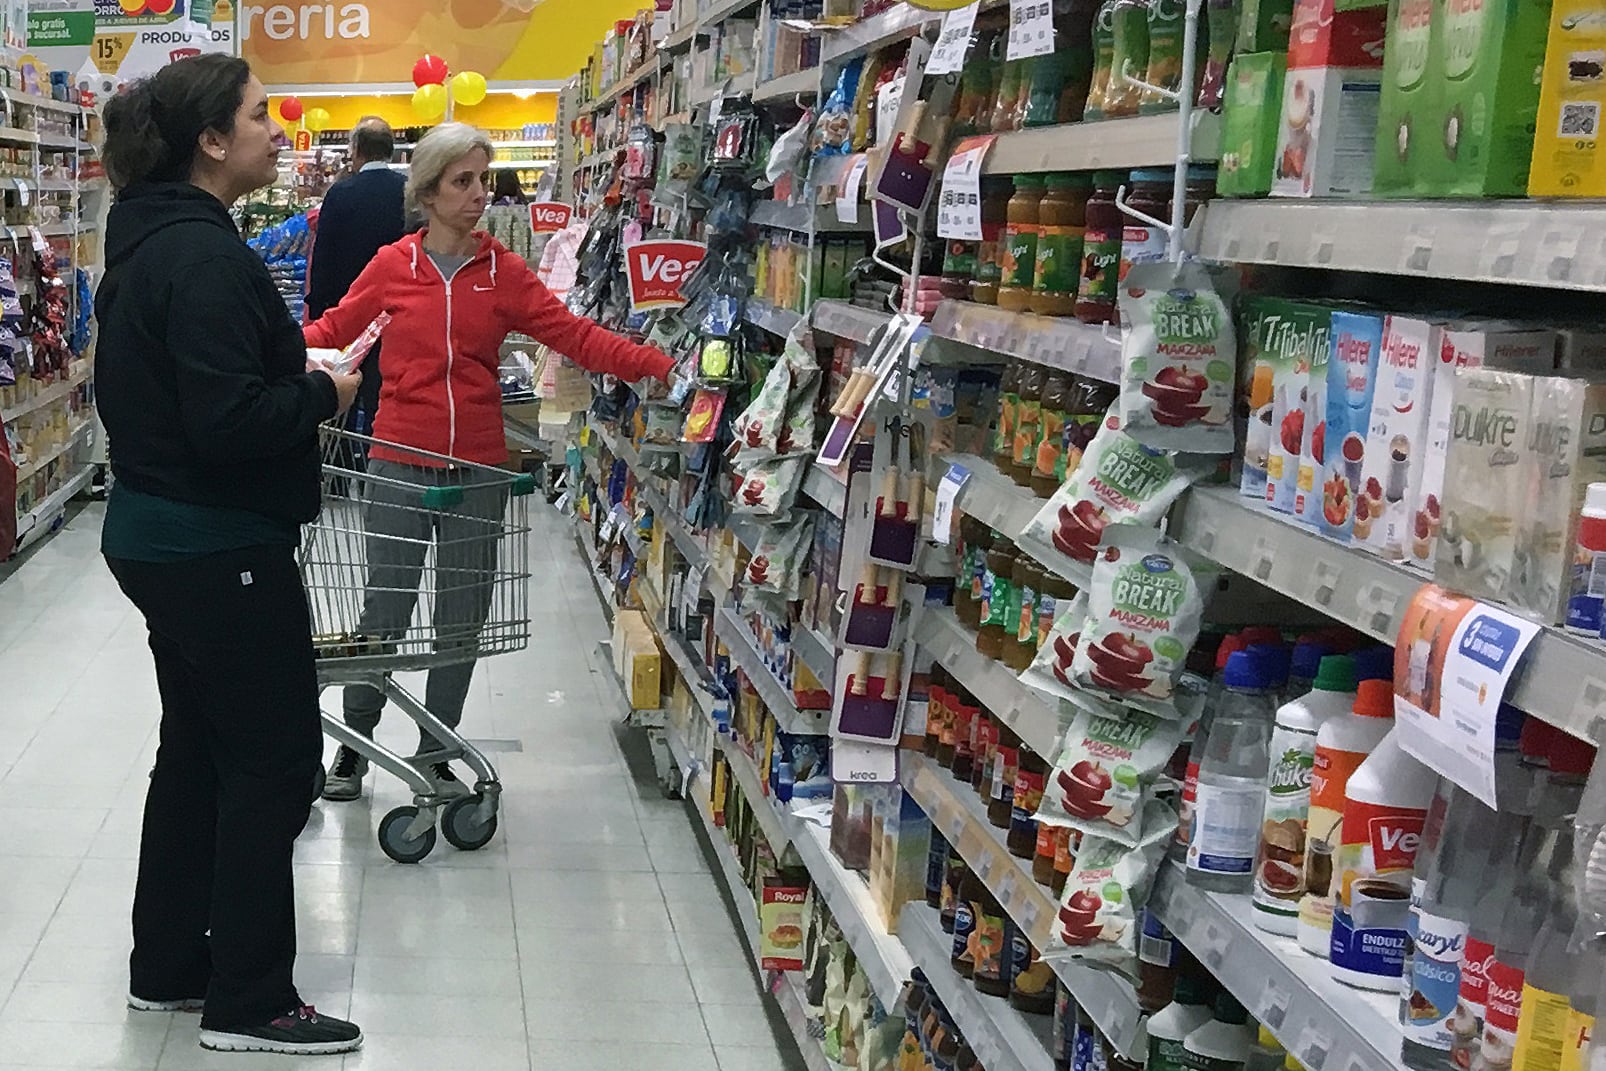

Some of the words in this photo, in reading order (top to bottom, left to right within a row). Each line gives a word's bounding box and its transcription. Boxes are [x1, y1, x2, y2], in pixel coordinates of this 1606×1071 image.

[41, 18, 66, 31] gratis
[96, 37, 122, 59] 15%
[141, 30, 231, 43] PRODUOS
[535, 208, 566, 224] Vea
[1093, 253, 1117, 269] Light
[1158, 313, 1216, 338] BREAK
[1156, 342, 1216, 356] MANZANA
[1112, 436, 1172, 481] Natural
[1100, 452, 1161, 501] BREAK
[1088, 475, 1142, 514] MANZANA
[1119, 565, 1185, 592] Natural
[1114, 580, 1180, 617] BREAK
[1108, 607, 1170, 633] MANZANA
[1463, 620, 1483, 648] 3
[1088, 718, 1149, 750] BREAK
[850, 770, 877, 780] krea
[774, 891, 805, 902] Royal
[1362, 933, 1405, 949] ENDULZ
